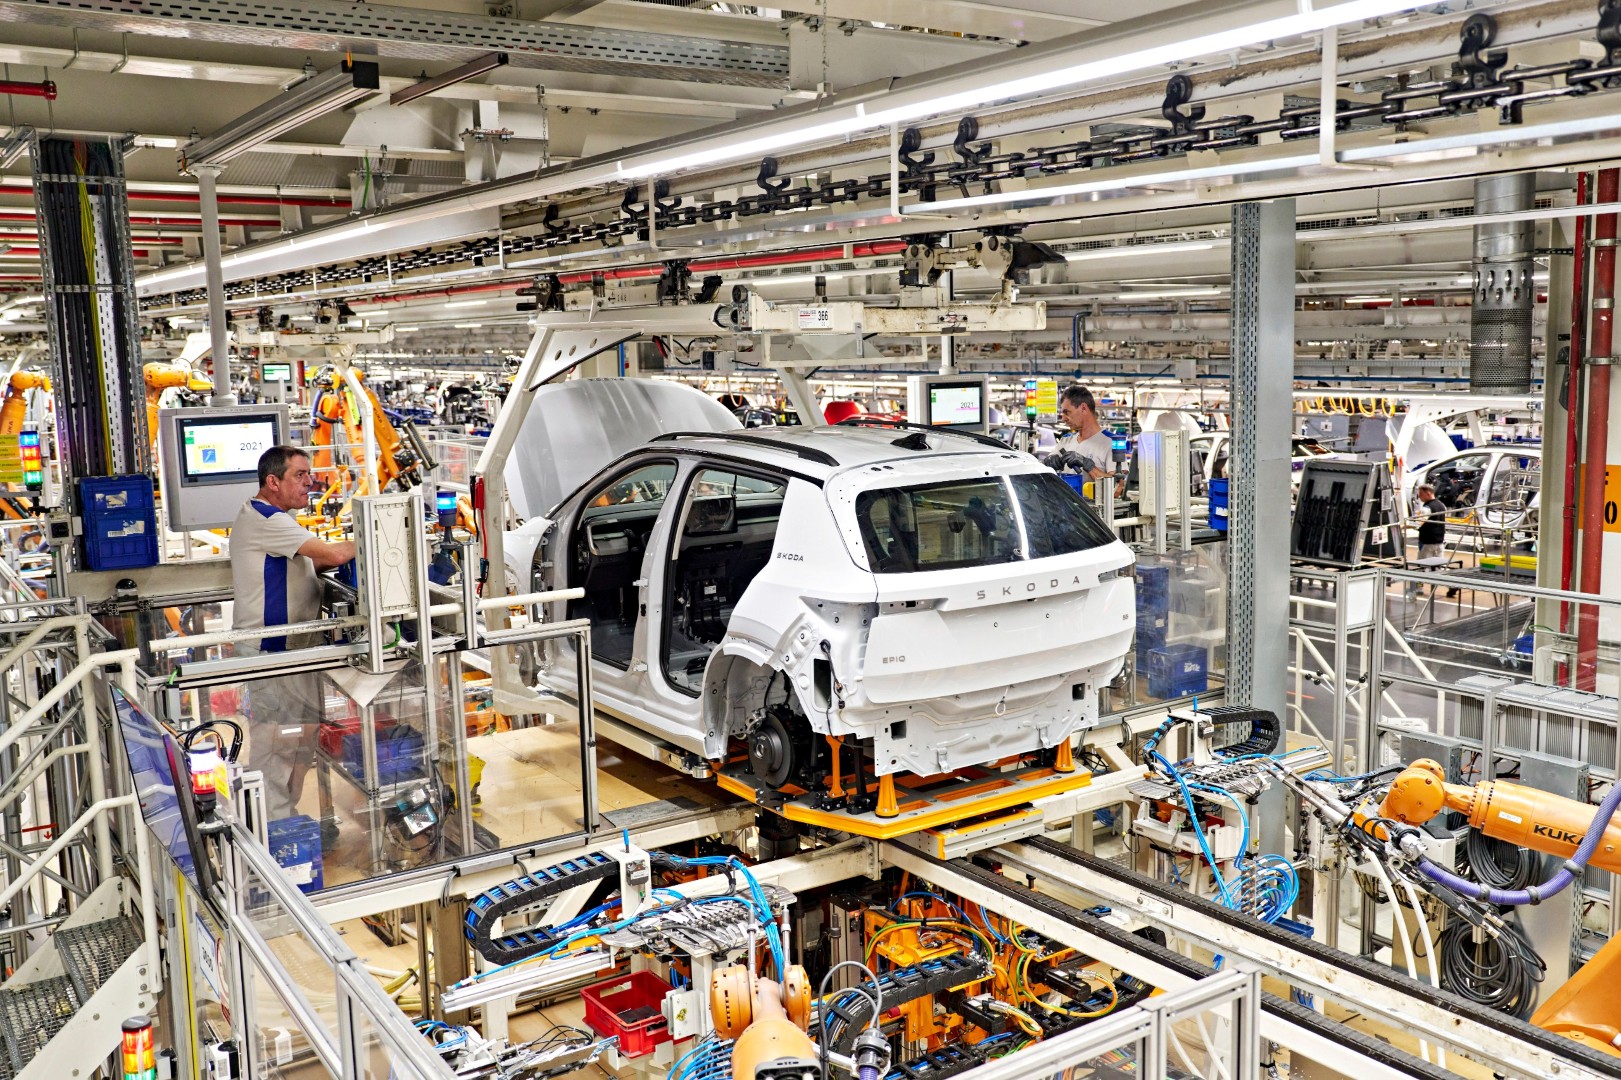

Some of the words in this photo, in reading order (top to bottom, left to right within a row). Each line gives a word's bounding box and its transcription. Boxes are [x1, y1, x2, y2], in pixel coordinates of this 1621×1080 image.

[960, 401, 974, 409] 2021
[240, 441, 263, 451] 2021
[976, 575, 1081, 600] SKODA
